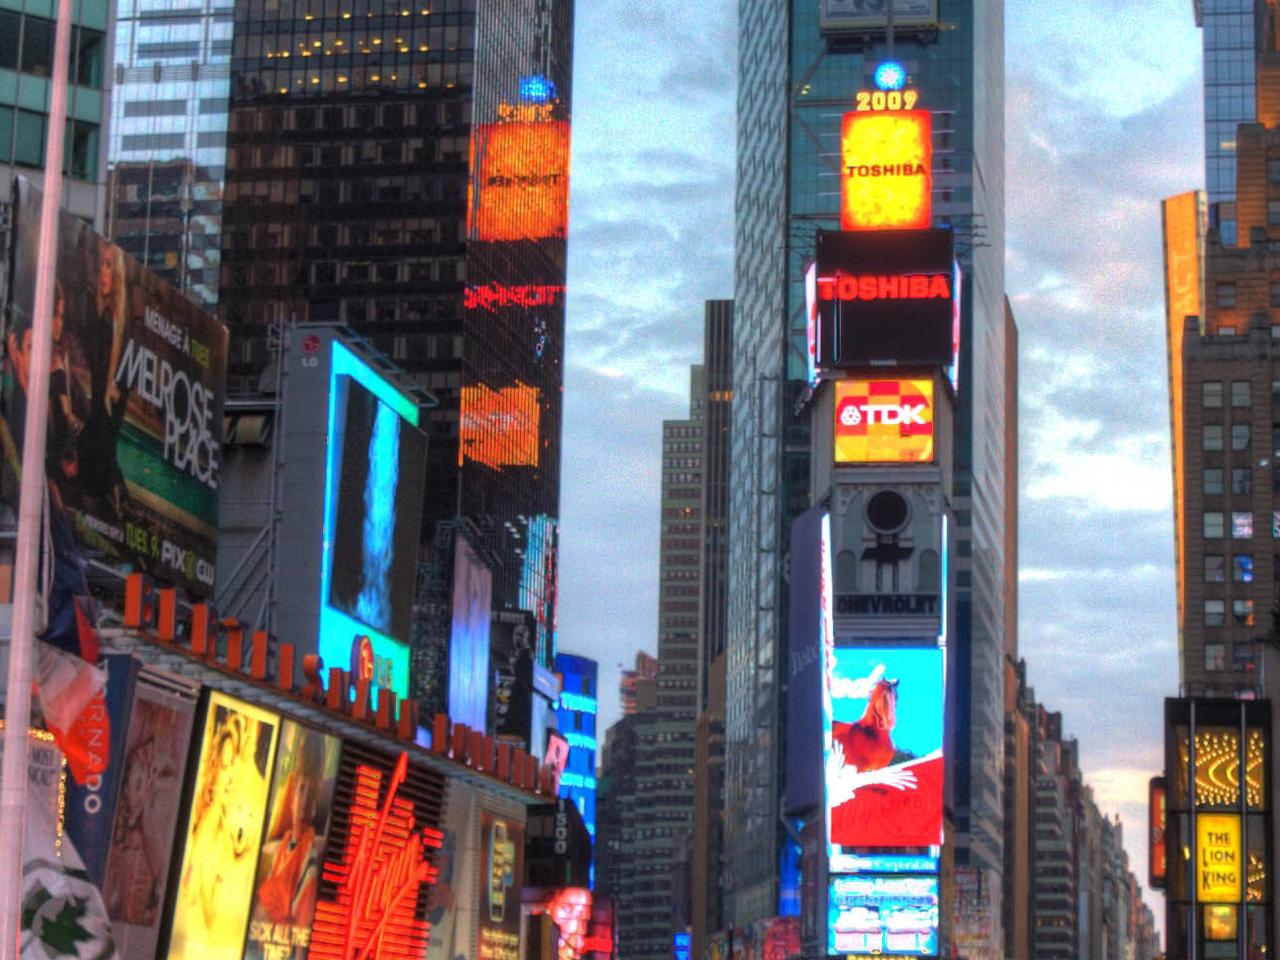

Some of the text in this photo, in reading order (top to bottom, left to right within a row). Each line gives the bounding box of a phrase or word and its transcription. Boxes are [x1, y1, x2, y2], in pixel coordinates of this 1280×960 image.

[856, 90, 918, 111] 2009
[847, 164, 926, 178] TOSHIBA
[817, 274, 950, 301] TOSHIBA
[116, 339, 214, 439] MELROSE
[860, 404, 926, 425] TDK
[164, 417, 219, 489] PLACE
[837, 595, 937, 614] CHEVROLET
[1208, 832, 1231, 844] THE
[1203, 848, 1236, 866] LION
[1203, 871, 1236, 890] KING
